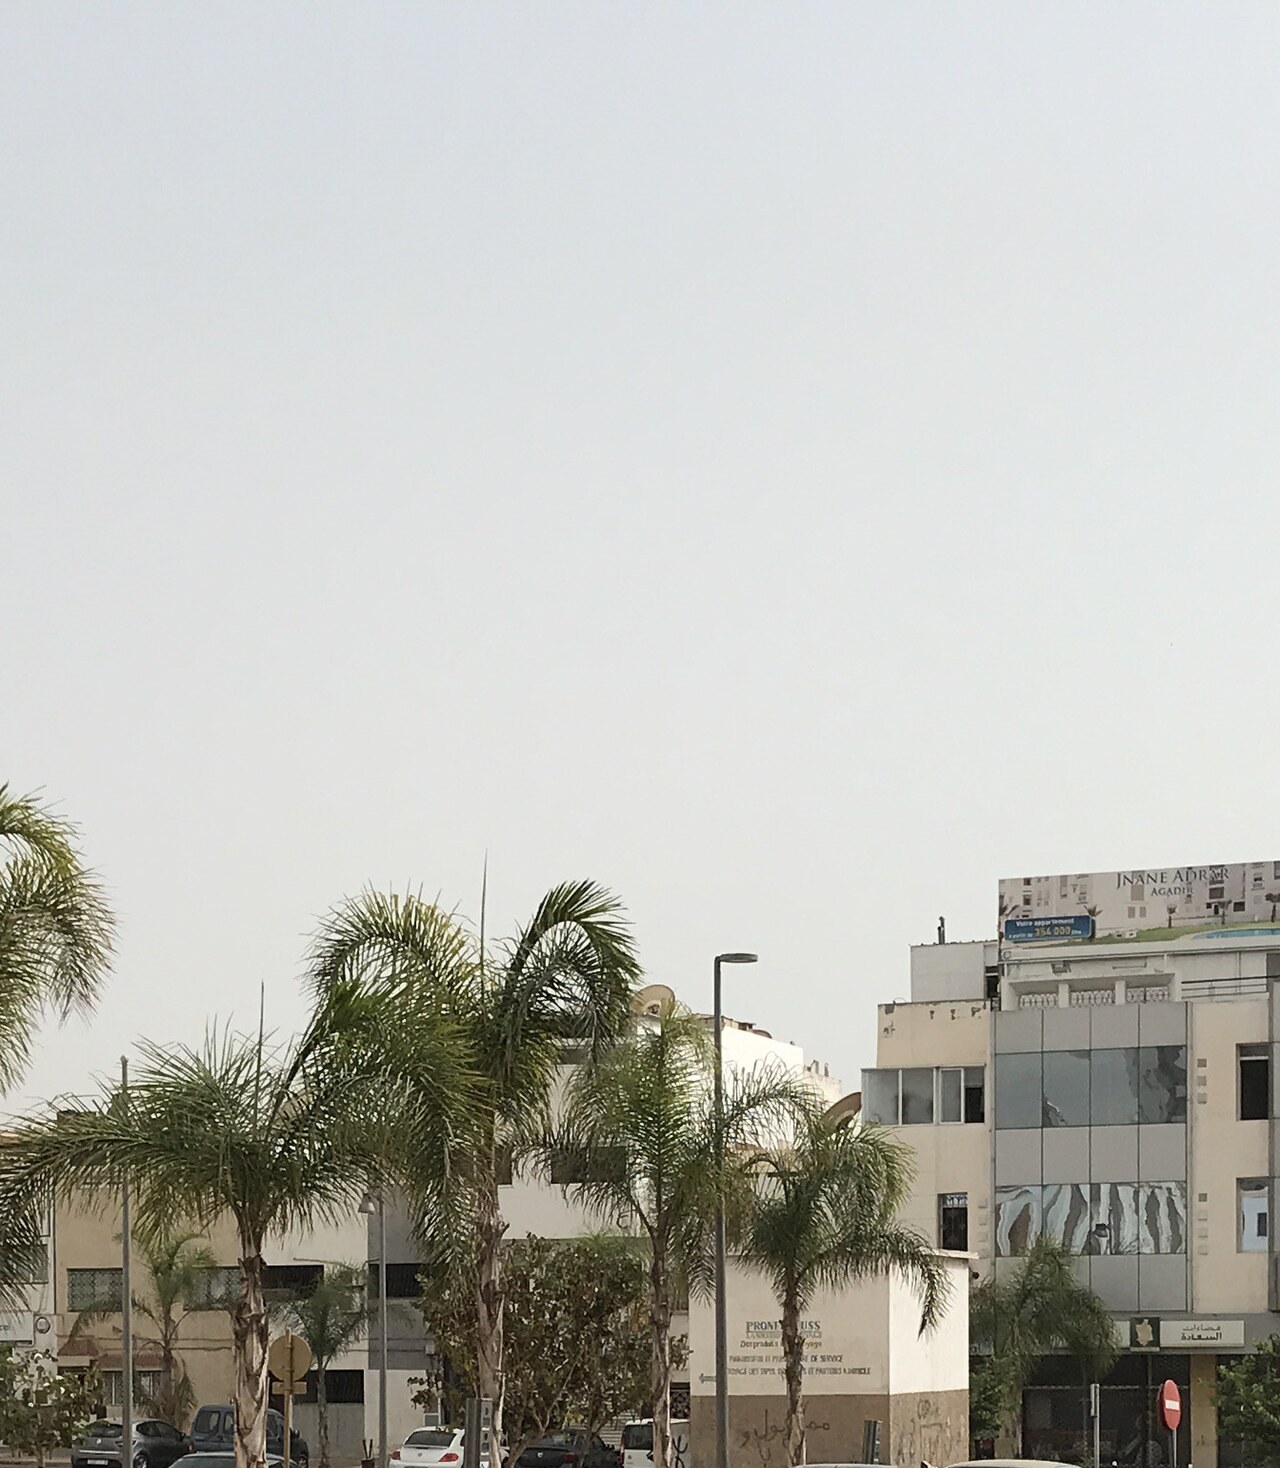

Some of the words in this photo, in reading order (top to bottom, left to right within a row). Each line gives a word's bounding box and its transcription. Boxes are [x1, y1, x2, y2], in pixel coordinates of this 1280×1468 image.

[1117, 871, 1168, 889] JNANE
[1173, 867, 1229, 883] ADRAR
[1151, 886, 1194, 897] AGADIR
[1181, 1332, 1222, 1340] السعادة
